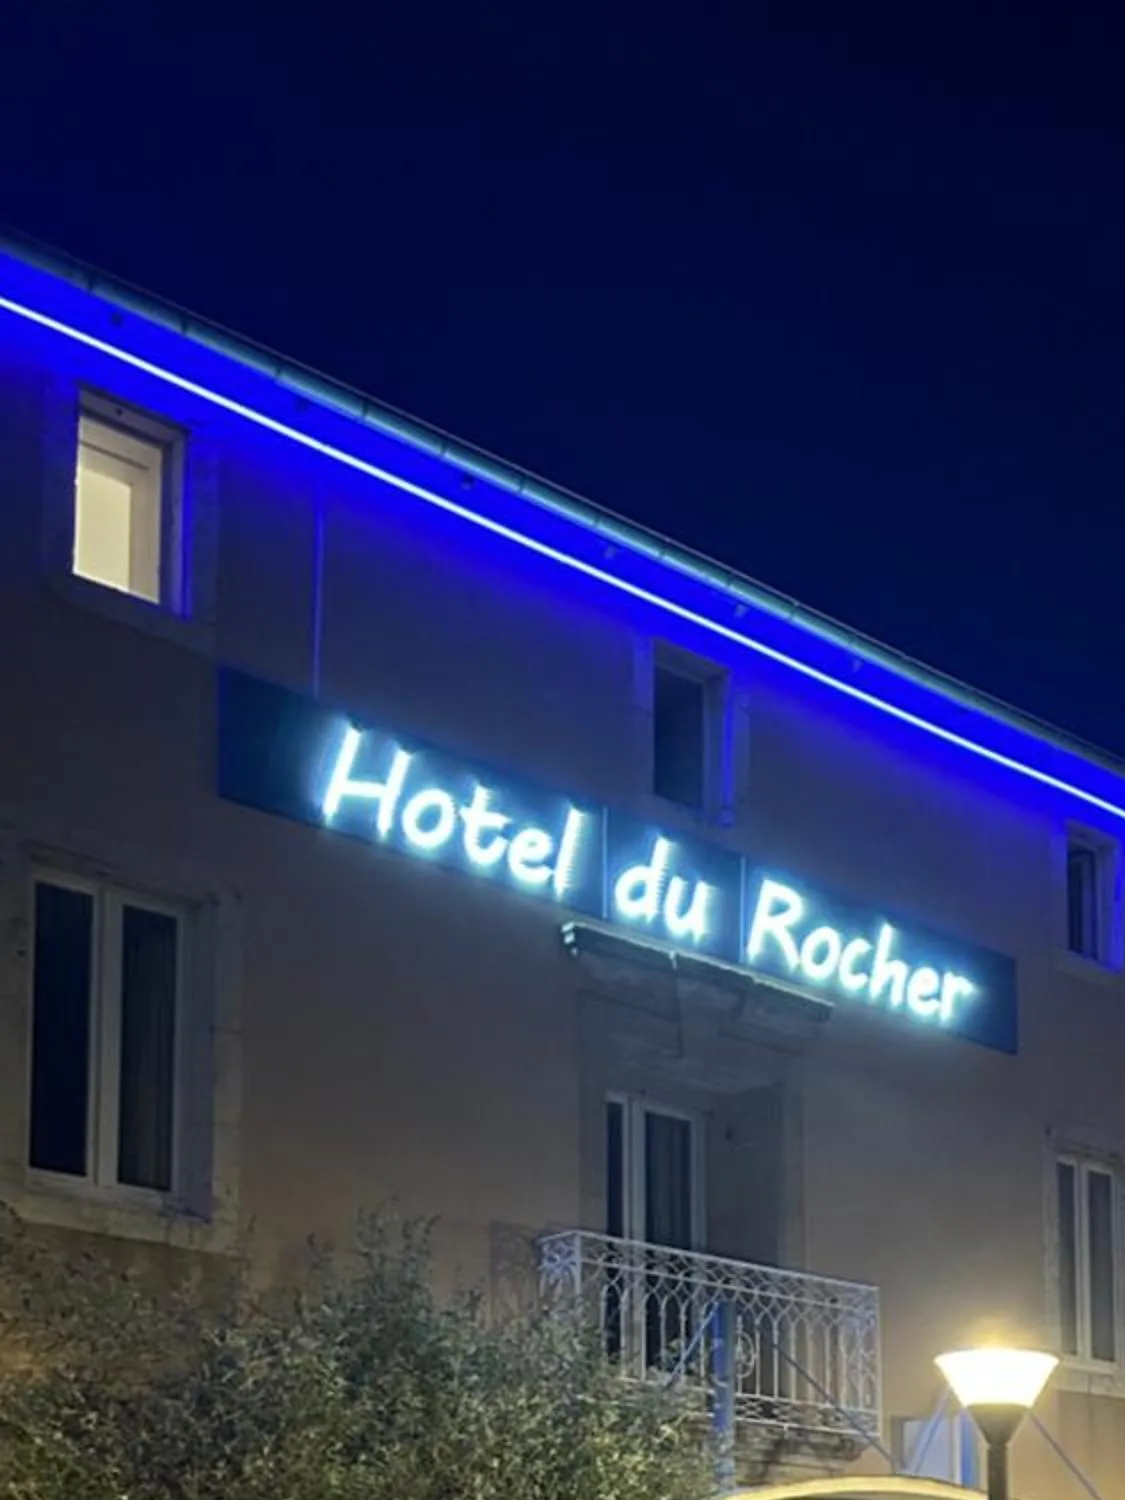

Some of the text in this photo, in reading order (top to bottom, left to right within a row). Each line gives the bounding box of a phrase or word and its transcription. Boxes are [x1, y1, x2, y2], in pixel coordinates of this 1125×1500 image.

[322, 725, 976, 1024] Hotel du Rocher
